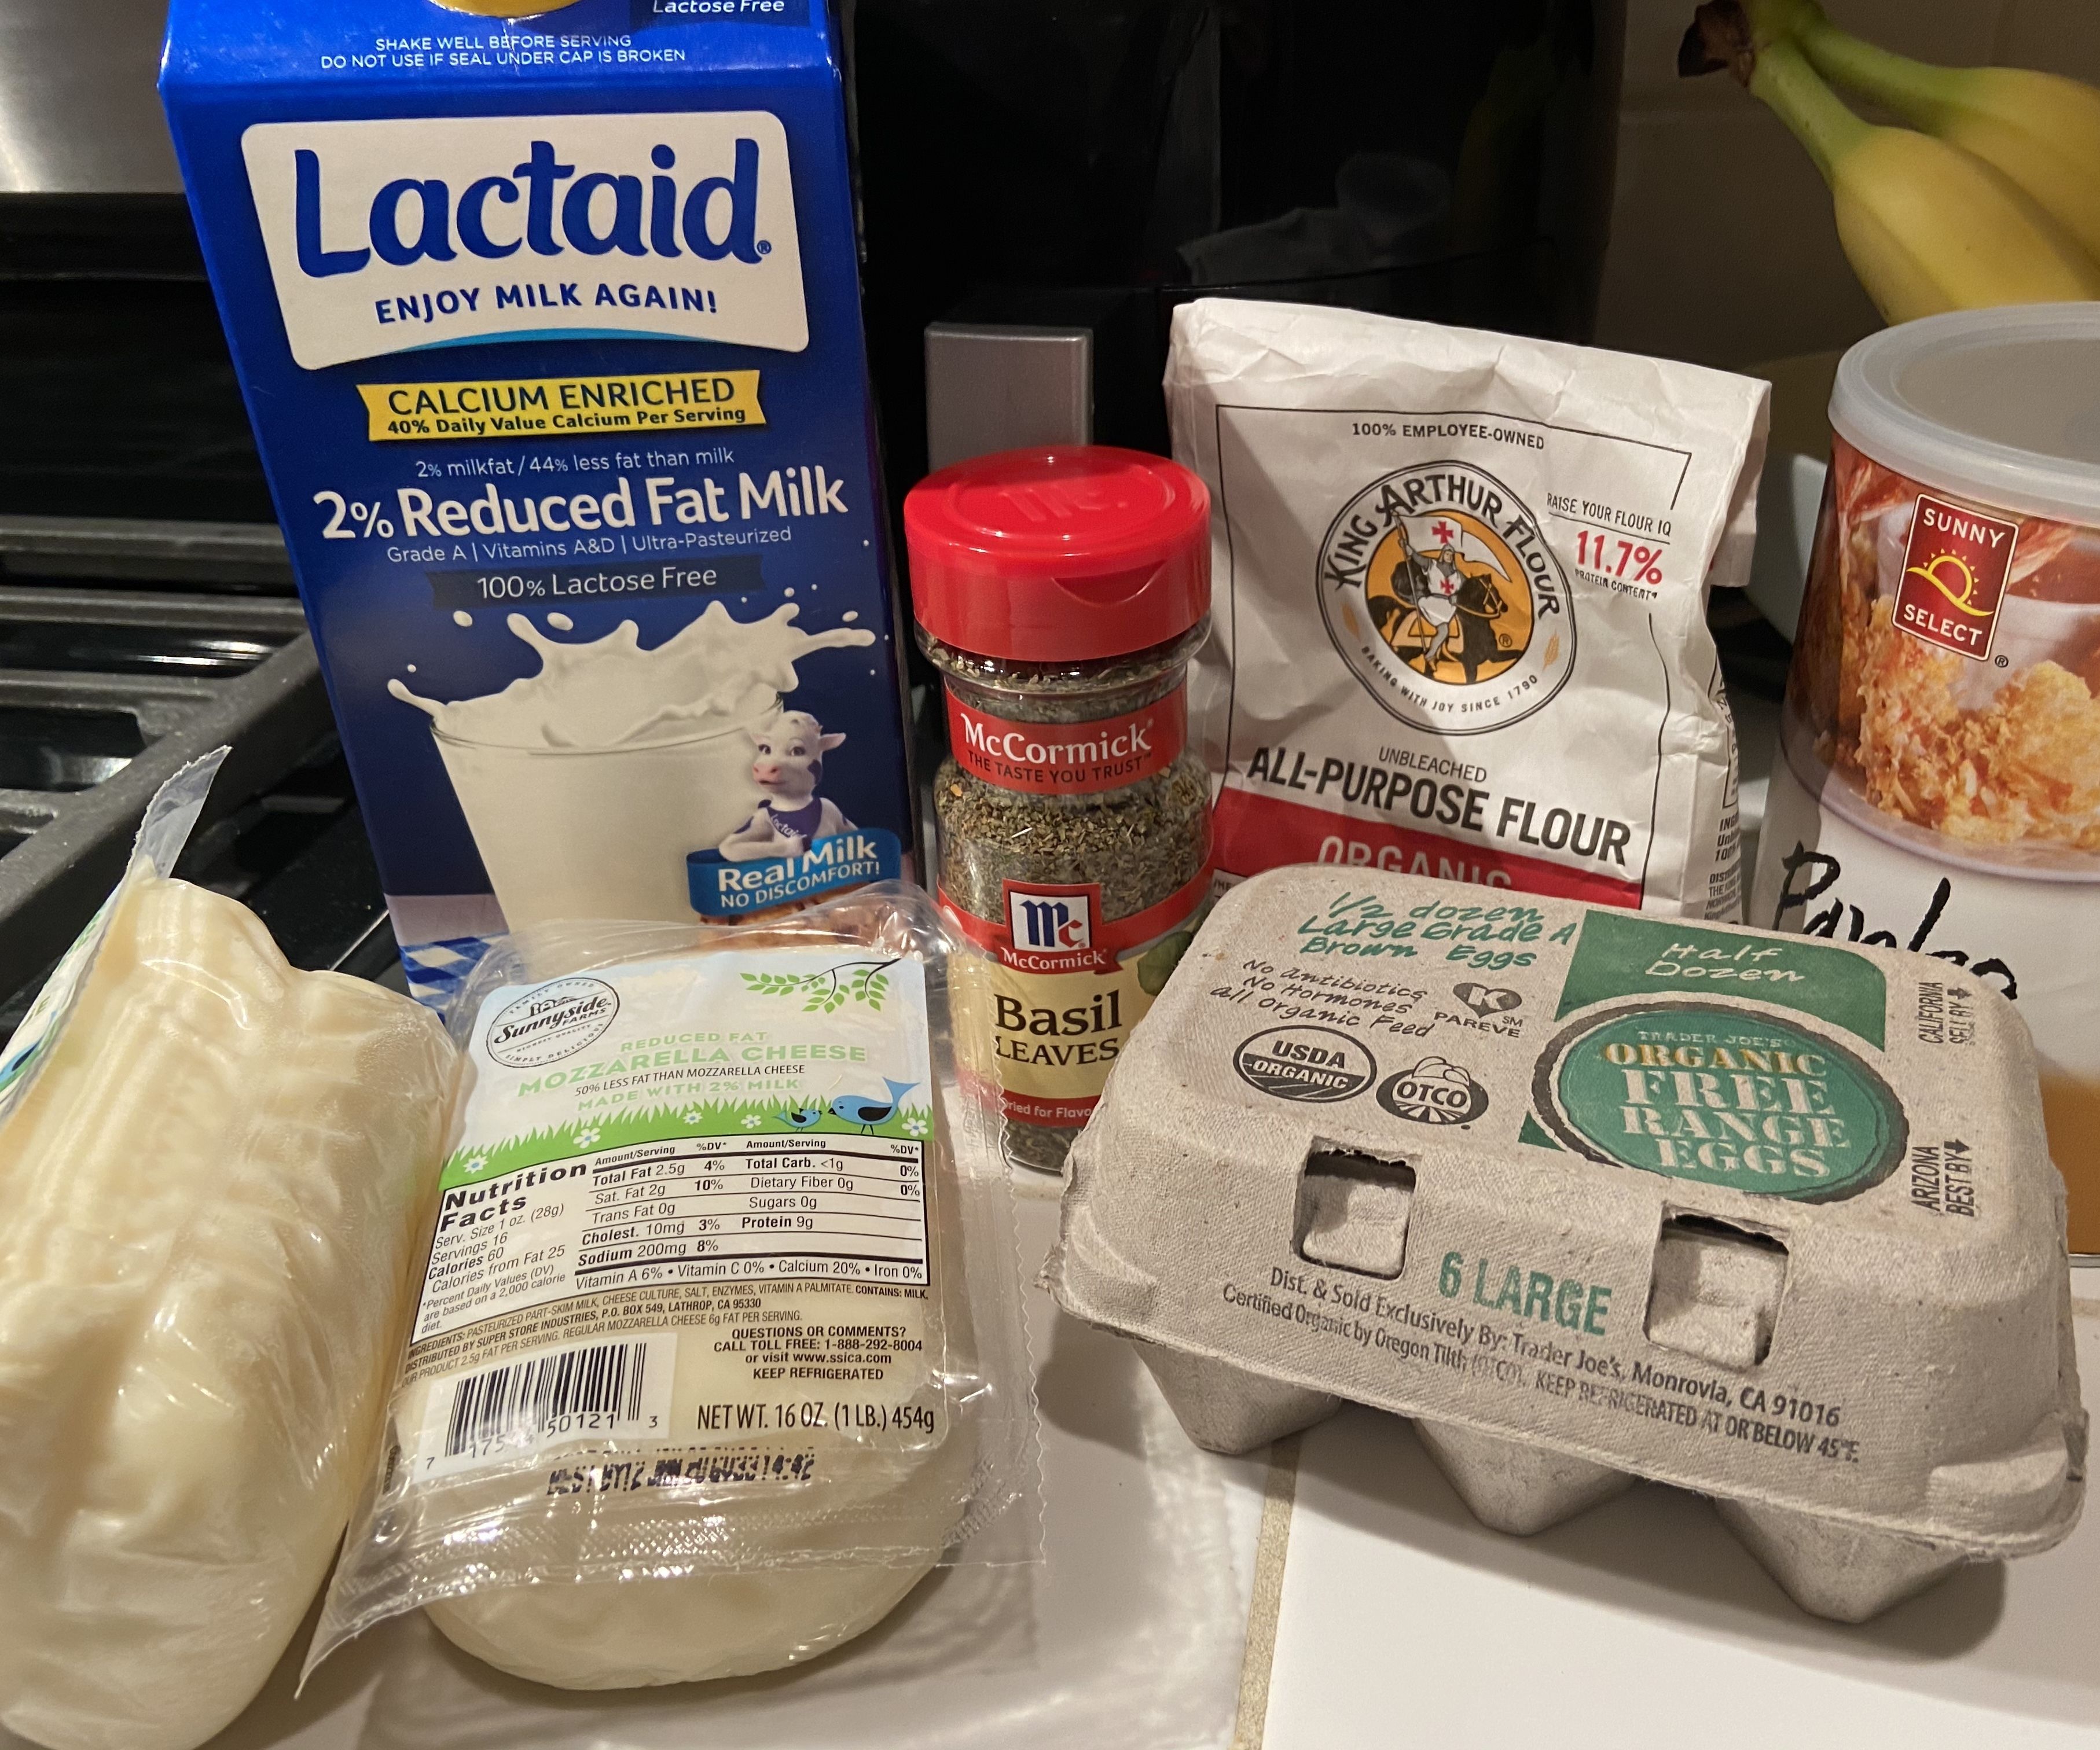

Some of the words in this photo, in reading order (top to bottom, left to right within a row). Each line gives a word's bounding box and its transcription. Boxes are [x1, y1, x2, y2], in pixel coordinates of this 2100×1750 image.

[653, 0, 735, 13] Lactose
[740, 0, 784, 12] Free
[321, 56, 347, 68] DO
[352, 54, 386, 67] NOT
[392, 54, 422, 67] USE
[430, 54, 443, 65] IF
[449, 53, 491, 65] SEAL
[497, 52, 554, 65] UNDER
[560, 51, 593, 63] CAP
[599, 50, 611, 62] IS
[618, 50, 685, 62] BROKEN
[376, 38, 431, 51] SHAKE
[436, 38, 484, 50] WELL
[490, 36, 554, 49] BEFORE
[560, 35, 631, 48] SERVING
[375, 288, 480, 325] ENJOY
[496, 284, 581, 309] MILK
[594, 284, 717, 314] AGAIN!
[388, 384, 549, 416] CALCIUM
[562, 378, 735, 410] ENRICHED
[388, 419, 429, 435] 40%
[436, 415, 486, 436] Daily
[491, 414, 546, 431] Value
[552, 412, 632, 429] Calcium
[637, 410, 669, 425] Per
[674, 407, 746, 425] Serving
[1353, 423, 1396, 437] 100%
[1403, 425, 1545, 450] EMPLOYEE-OWNED
[314, 490, 394, 539] 2%
[397, 476, 635, 535] Reduced
[648, 476, 732, 524] Fat
[740, 465, 848, 520] Milk
[1547, 492, 1577, 513] RAISE
[1583, 500, 1611, 521] YOUR
[1614, 509, 1653, 532] FLOUR
[1658, 520, 1671, 537] IQ
[387, 545, 445, 563] Grade
[452, 543, 467, 560] A
[483, 539, 567, 559] Vitamins
[573, 537, 614, 555] A&D
[633, 525, 792, 552] Ultra-Pasteurized
[1923, 508, 2005, 549] SUNNY
[1324, 514, 1378, 591] KING
[1376, 474, 1502, 530] ARTHUR
[1502, 516, 1559, 619] FLOUR
[1577, 530, 1662, 585] 11.7%
[478, 576, 546, 600] 100%
[552, 571, 654, 595] Lactose
[662, 567, 717, 588] Free
[1903, 604, 1982, 646] SELECT
[1361, 646, 1397, 688] BAKING
[1400, 686, 1428, 708] WITH
[1432, 701, 1454, 712] JOY
[1461, 696, 1501, 713] SINCE
[1507, 674, 1539, 700] 1790
[961, 713, 1152, 764] McCormick
[968, 750, 991, 771] THE
[997, 762, 1043, 782] TASTE
[1050, 770, 1086, 784] YOU
[1378, 747, 1487, 783] UNBLEACHED
[1247, 747, 1489, 832] ALL-PURPOSE
[1496, 797, 1631, 866] FLOUR
[718, 858, 793, 891] Real
[803, 835, 877, 872] Milk
[721, 893, 750, 908] NO
[755, 861, 879, 904] DISCOMFORT!
[1330, 892, 1394, 919] 1/2
[1409, 900, 1544, 923] dozen
[1297, 915, 1416, 939] Large
[1420, 922, 1544, 943] Grade
[1548, 923, 1577, 944] A
[1001, 947, 1105, 969] McCormick
[1243, 959, 1274, 975] No
[1299, 936, 1418, 958] Brown
[1445, 944, 1537, 969] Eggs
[1661, 943, 1782, 962] Half
[1646, 961, 1805, 982] Dozen
[1243, 976, 1275, 991] No
[1282, 983, 1413, 1014] Hormones
[493, 997, 606, 1045] Sunnyside
[563, 1008, 607, 1027] FARMS
[994, 990, 1122, 1036] Basil
[1371, 1016, 1434, 1038] Feed
[1434, 1012, 1521, 1038] PAREVE
[621, 1031, 719, 1053] REDUCED
[728, 1031, 767, 1042] FAT
[996, 1036, 1119, 1066] LEAVES
[1272, 1041, 1345, 1068] USDA
[1638, 1031, 1716, 1045] TRADER
[1725, 1035, 1781, 1047] JOE'S
[517, 1047, 729, 1097] MOZZARELLA
[741, 1046, 866, 1061] CHEESE
[1252, 1060, 1350, 1089] ORGANIC
[1603, 1043, 1826, 1077] ORGANIC
[575, 1082, 600, 1097] 50%
[603, 1076, 629, 1092] LESS
[632, 1073, 650, 1086] FAT
[652, 1071, 681, 1083] THAN
[689, 1065, 762, 1078] MOZZARELLA
[765, 1063, 805, 1075] CHEESE
[578, 1091, 638, 1111] MADE
[646, 1081, 702, 1098] WITH
[709, 1080, 740, 1093] 2%
[748, 1078, 800, 1090] MILK
[1396, 1081, 1468, 1108] OTCO
[1621, 1070, 1836, 1115] FREE
[1620, 1106, 1851, 1148] RANGE
[1654, 1139, 1830, 1178] EGGS
[1944, 1153, 1971, 1175] BY
[445, 1163, 587, 1211] Nutrition
[1911, 1146, 1940, 1211] ARIZONA
[439, 1194, 527, 1232] Facts
[1946, 1178, 1975, 1217] BEST
[1439, 1251, 1463, 1298] 6
[1473, 1257, 1613, 1336] LARGE
[714, 1341, 748, 1352] CALL
[752, 1340, 781, 1351] TOLL
[785, 1339, 820, 1350] FREE:
[825, 1339, 922, 1351] 1-888-292-8004
[732, 1327, 803, 1339] QUESTIONS
[807, 1327, 824, 1337] OR
[828, 1327, 906, 1337] COMMENTS?
[1270, 1267, 1308, 1295] Dist.
[1313, 1279, 1328, 1299] &
[1331, 1284, 1371, 1312] Sold
[1376, 1296, 1475, 1343] Exclusively
[1479, 1325, 1508, 1350] By:
[1512, 1332, 1572, 1366] Trader
[1632, 1361, 1732, 1407] Monrovia,
[1739, 1387, 1766, 1412] CA
[1772, 1395, 1841, 1427] 91016
[746, 1354, 759, 1364] or
[763, 1352, 789, 1363] visit
[794, 1353, 891, 1363] www.ssica.com
[754, 1368, 785, 1380] KEEP
[790, 1367, 883, 1380] REFRIGERATED
[698, 1405, 733, 1430] NET
[737, 1404, 769, 1429] WT.
[775, 1404, 795, 1428] 16
[801, 1402, 828, 1428] OZ.
[835, 1403, 850, 1428] (1
[856, 1404, 886, 1431] LB.)
[893, 1406, 934, 1433] 454g
